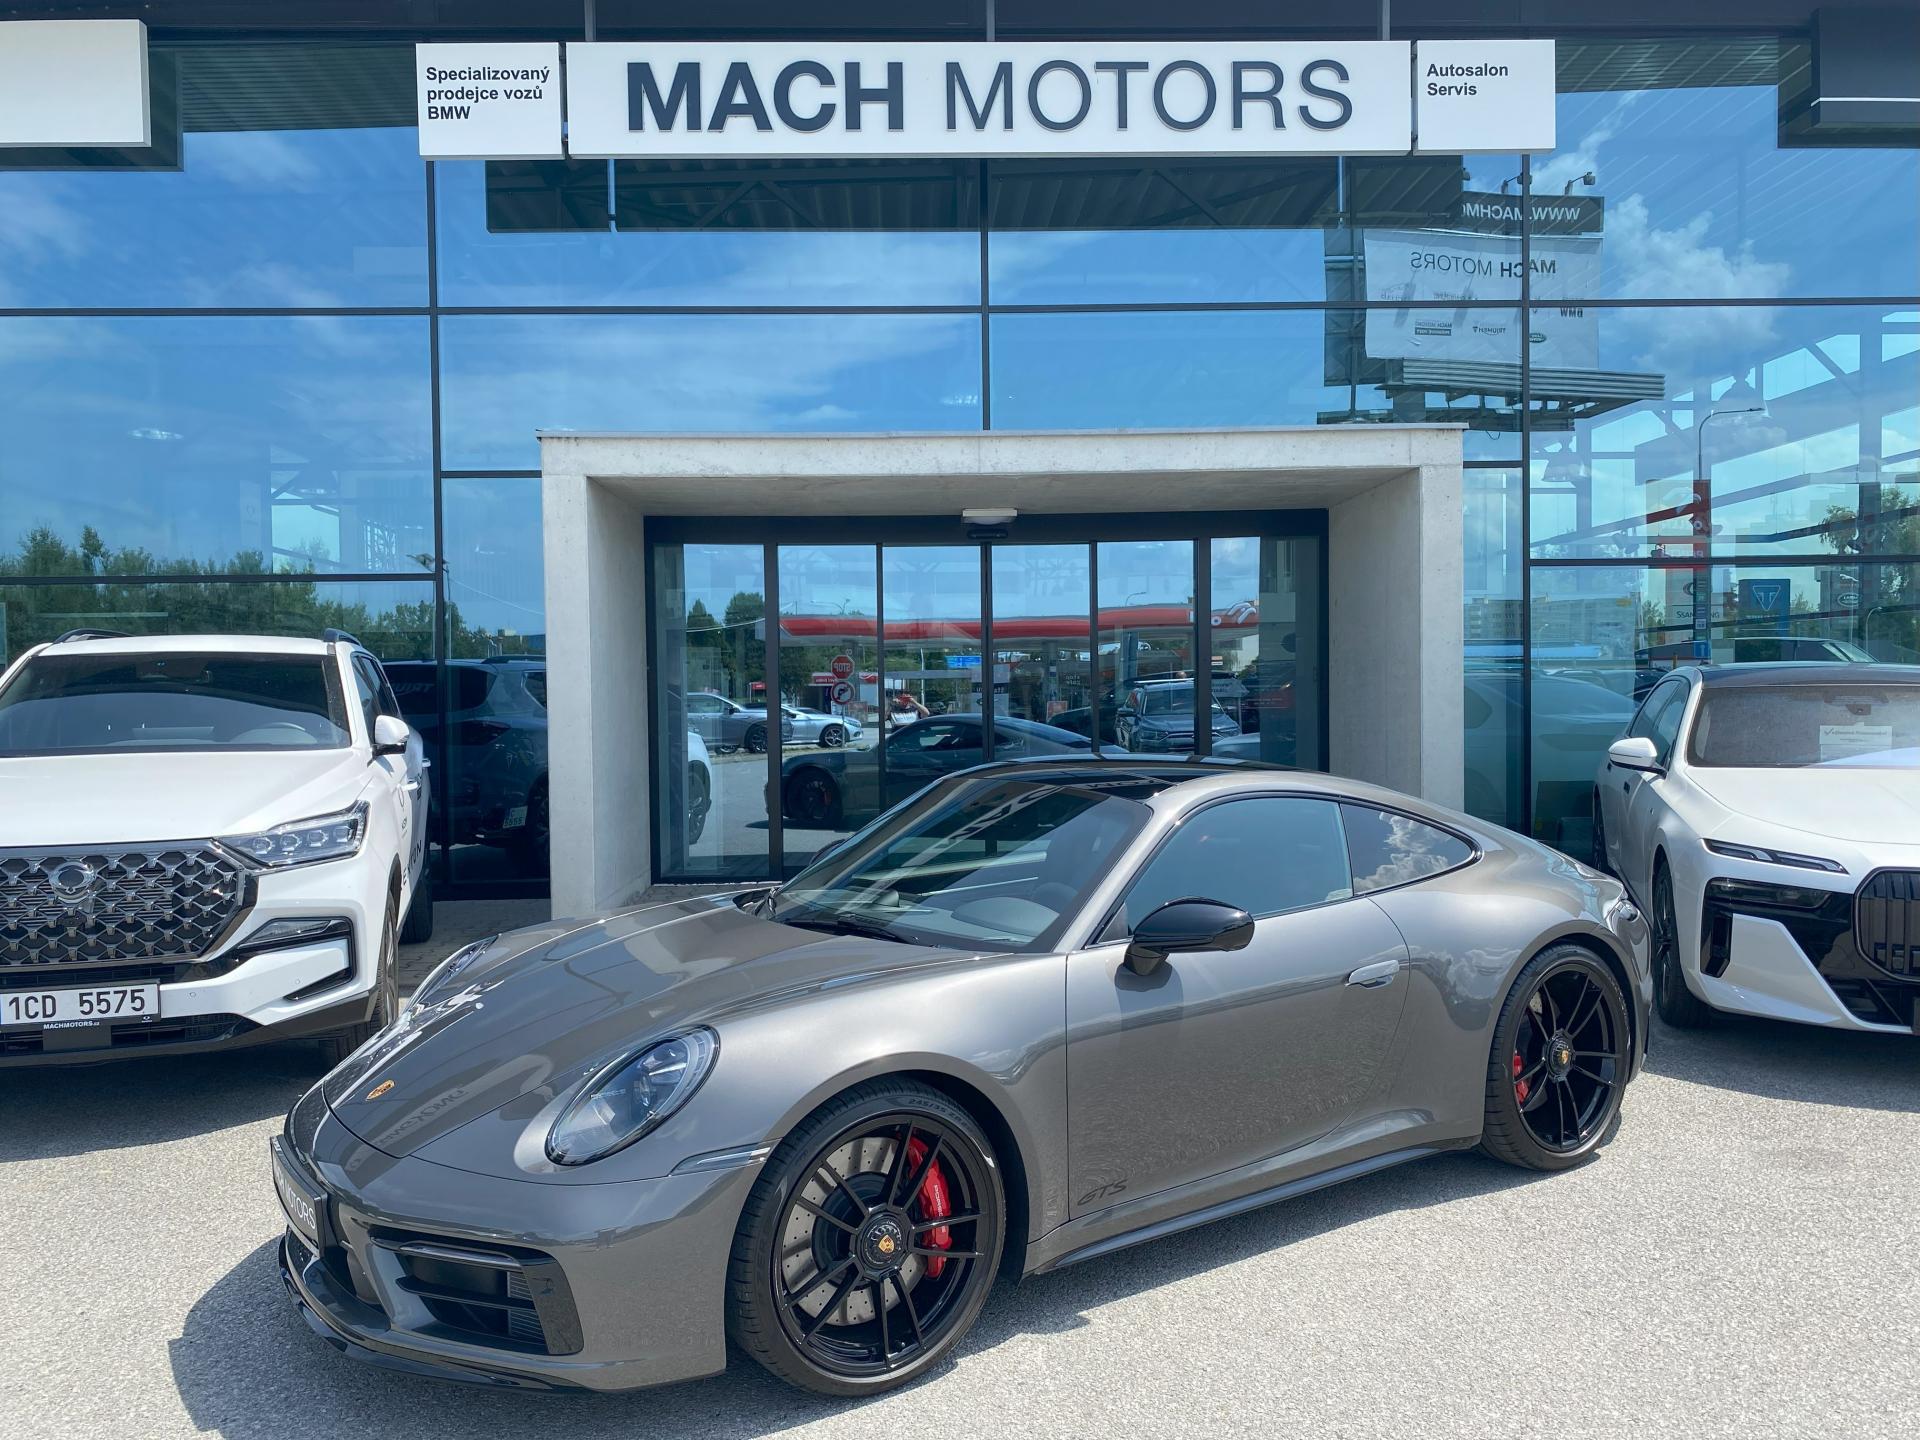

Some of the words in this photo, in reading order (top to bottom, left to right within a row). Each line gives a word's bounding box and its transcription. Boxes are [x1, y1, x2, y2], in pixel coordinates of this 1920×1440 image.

[426, 66, 550, 84] Specializovaný
[1427, 63, 1508, 77] Autosalon
[427, 86, 499, 103] prodejce
[503, 85, 543, 100] vozů
[627, 60, 904, 132] MACH
[946, 59, 1354, 133] MOTORS
[1427, 82, 1477, 96] Servis
[427, 106, 471, 120] BMW
[9, 995, 57, 1020] 1CD
[79, 989, 146, 1016] 5575
[1077, 1179, 1129, 1206] GTS
